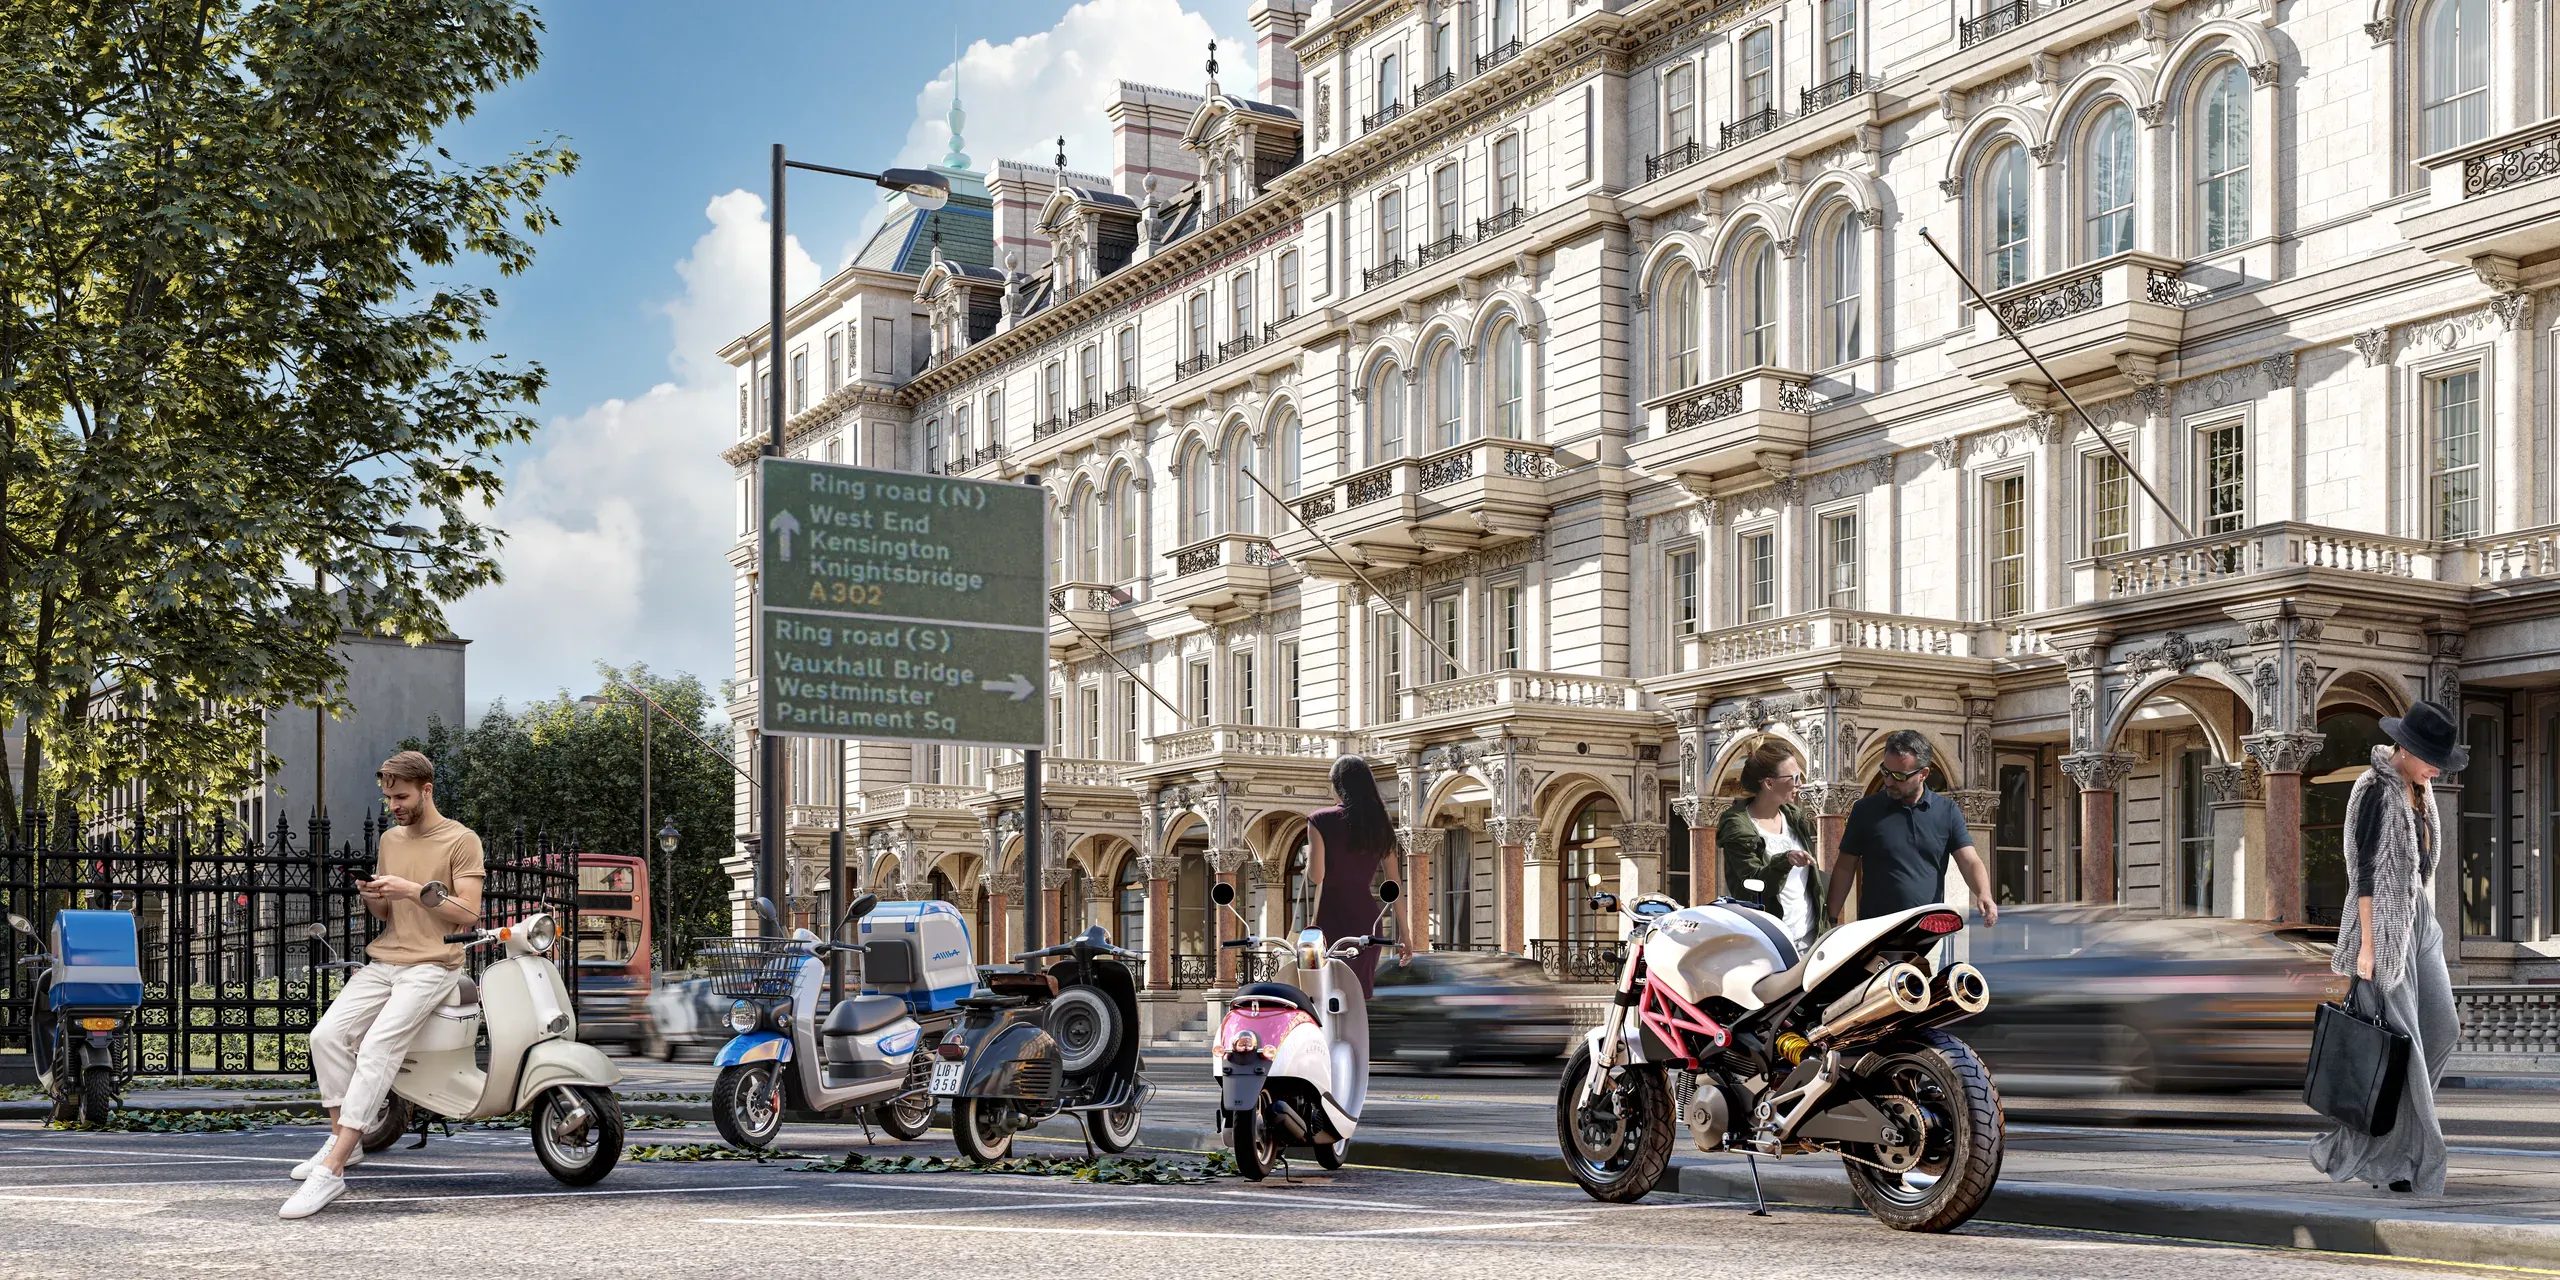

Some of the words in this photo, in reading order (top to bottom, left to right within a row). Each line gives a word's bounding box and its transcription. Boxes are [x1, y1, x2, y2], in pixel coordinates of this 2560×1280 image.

[810, 473, 865, 500] Ring
[875, 483, 932, 503] road
[938, 484, 987, 510] (N)
[809, 504, 873, 530] West
[883, 511, 930, 535] End
[810, 530, 950, 561] Kensington
[810, 555, 983, 592] Knightsbridge
[809, 581, 883, 606] A302
[776, 619, 832, 646] Ring
[842, 627, 899, 648] road
[905, 627, 951, 653] (S)
[774, 650, 884, 678] Vauxhall
[894, 659, 974, 687] Bridge
[775, 677, 934, 705] Westminster
[776, 702, 914, 728] Parliament
[923, 710, 956, 734] Sq
[588, 918, 605, 928] 139
[933, 1078, 957, 1091] 358
